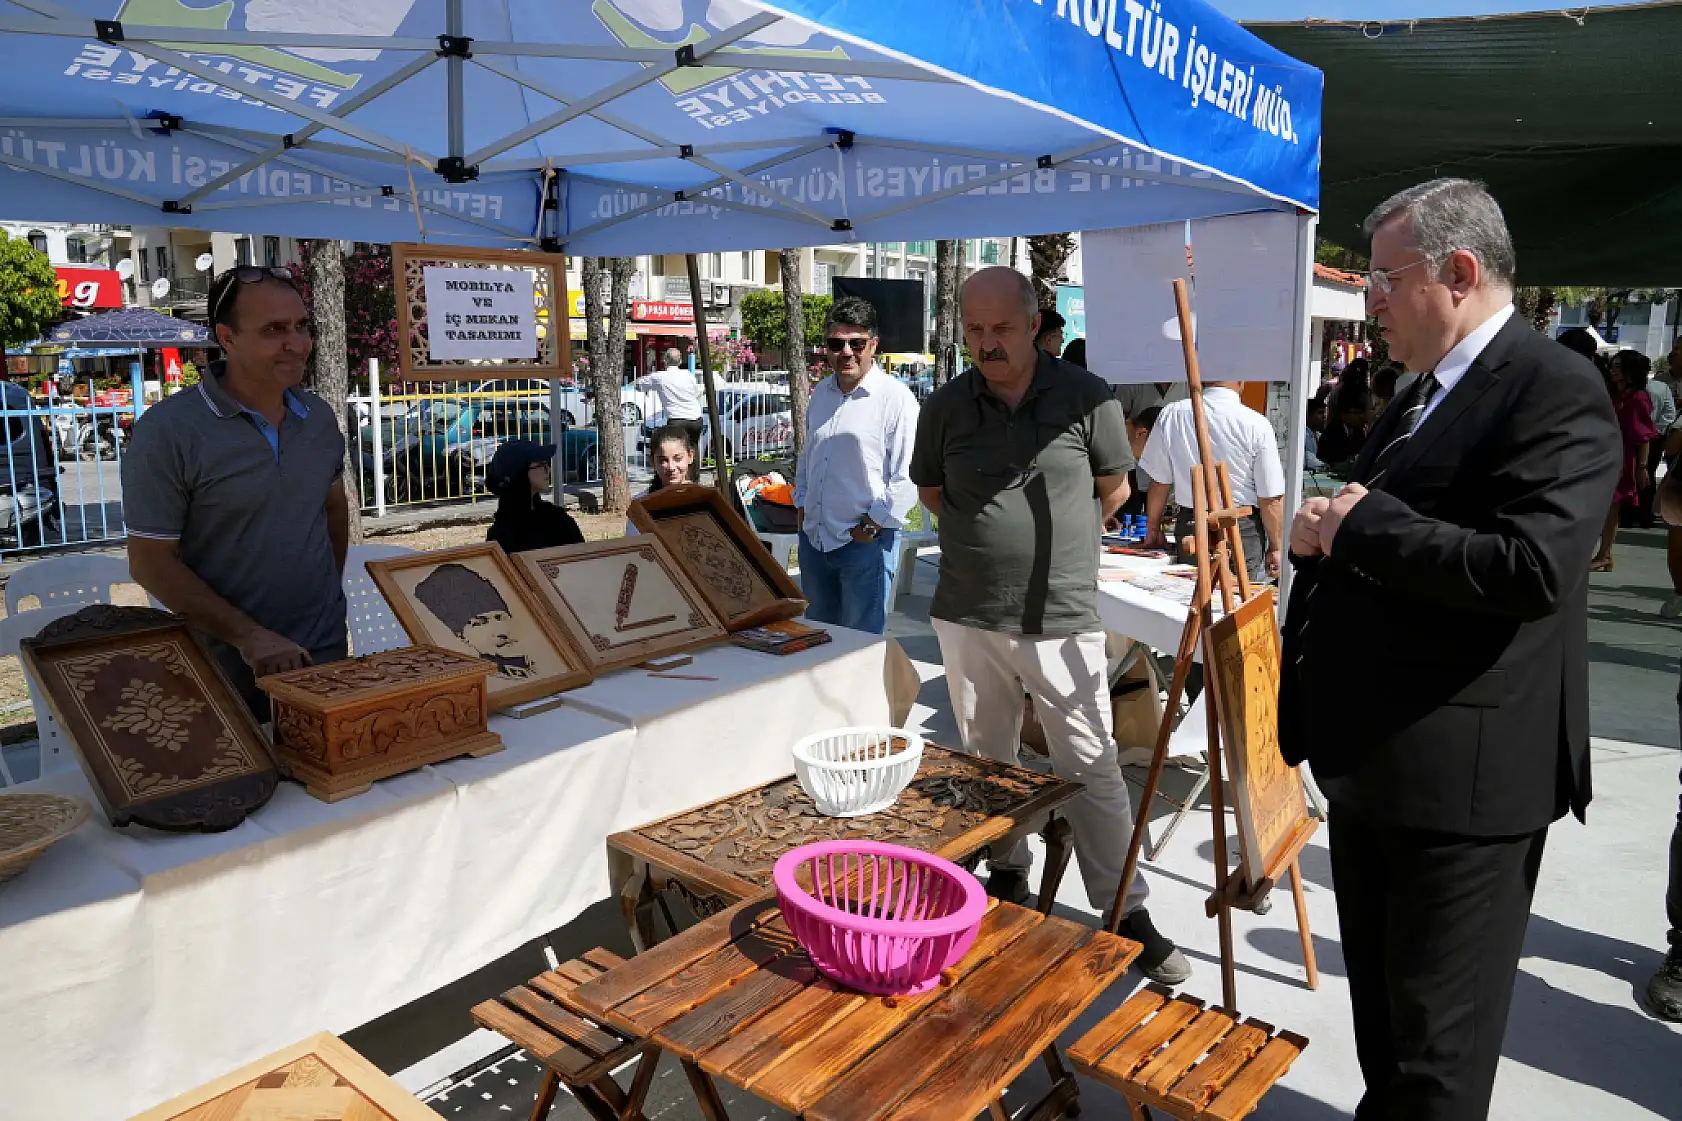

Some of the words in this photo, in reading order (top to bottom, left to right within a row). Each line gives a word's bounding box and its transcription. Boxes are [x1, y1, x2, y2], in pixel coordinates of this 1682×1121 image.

[1182, 25, 1255, 121] İŞLERİ
[1253, 84, 1299, 145] MÜD.
[445, 280, 515, 293] MOBİLYA
[472, 297, 493, 308] VE
[445, 311, 461, 328] İÇ
[465, 314, 519, 326] MEKAN
[445, 329, 522, 341] TASARIMI
